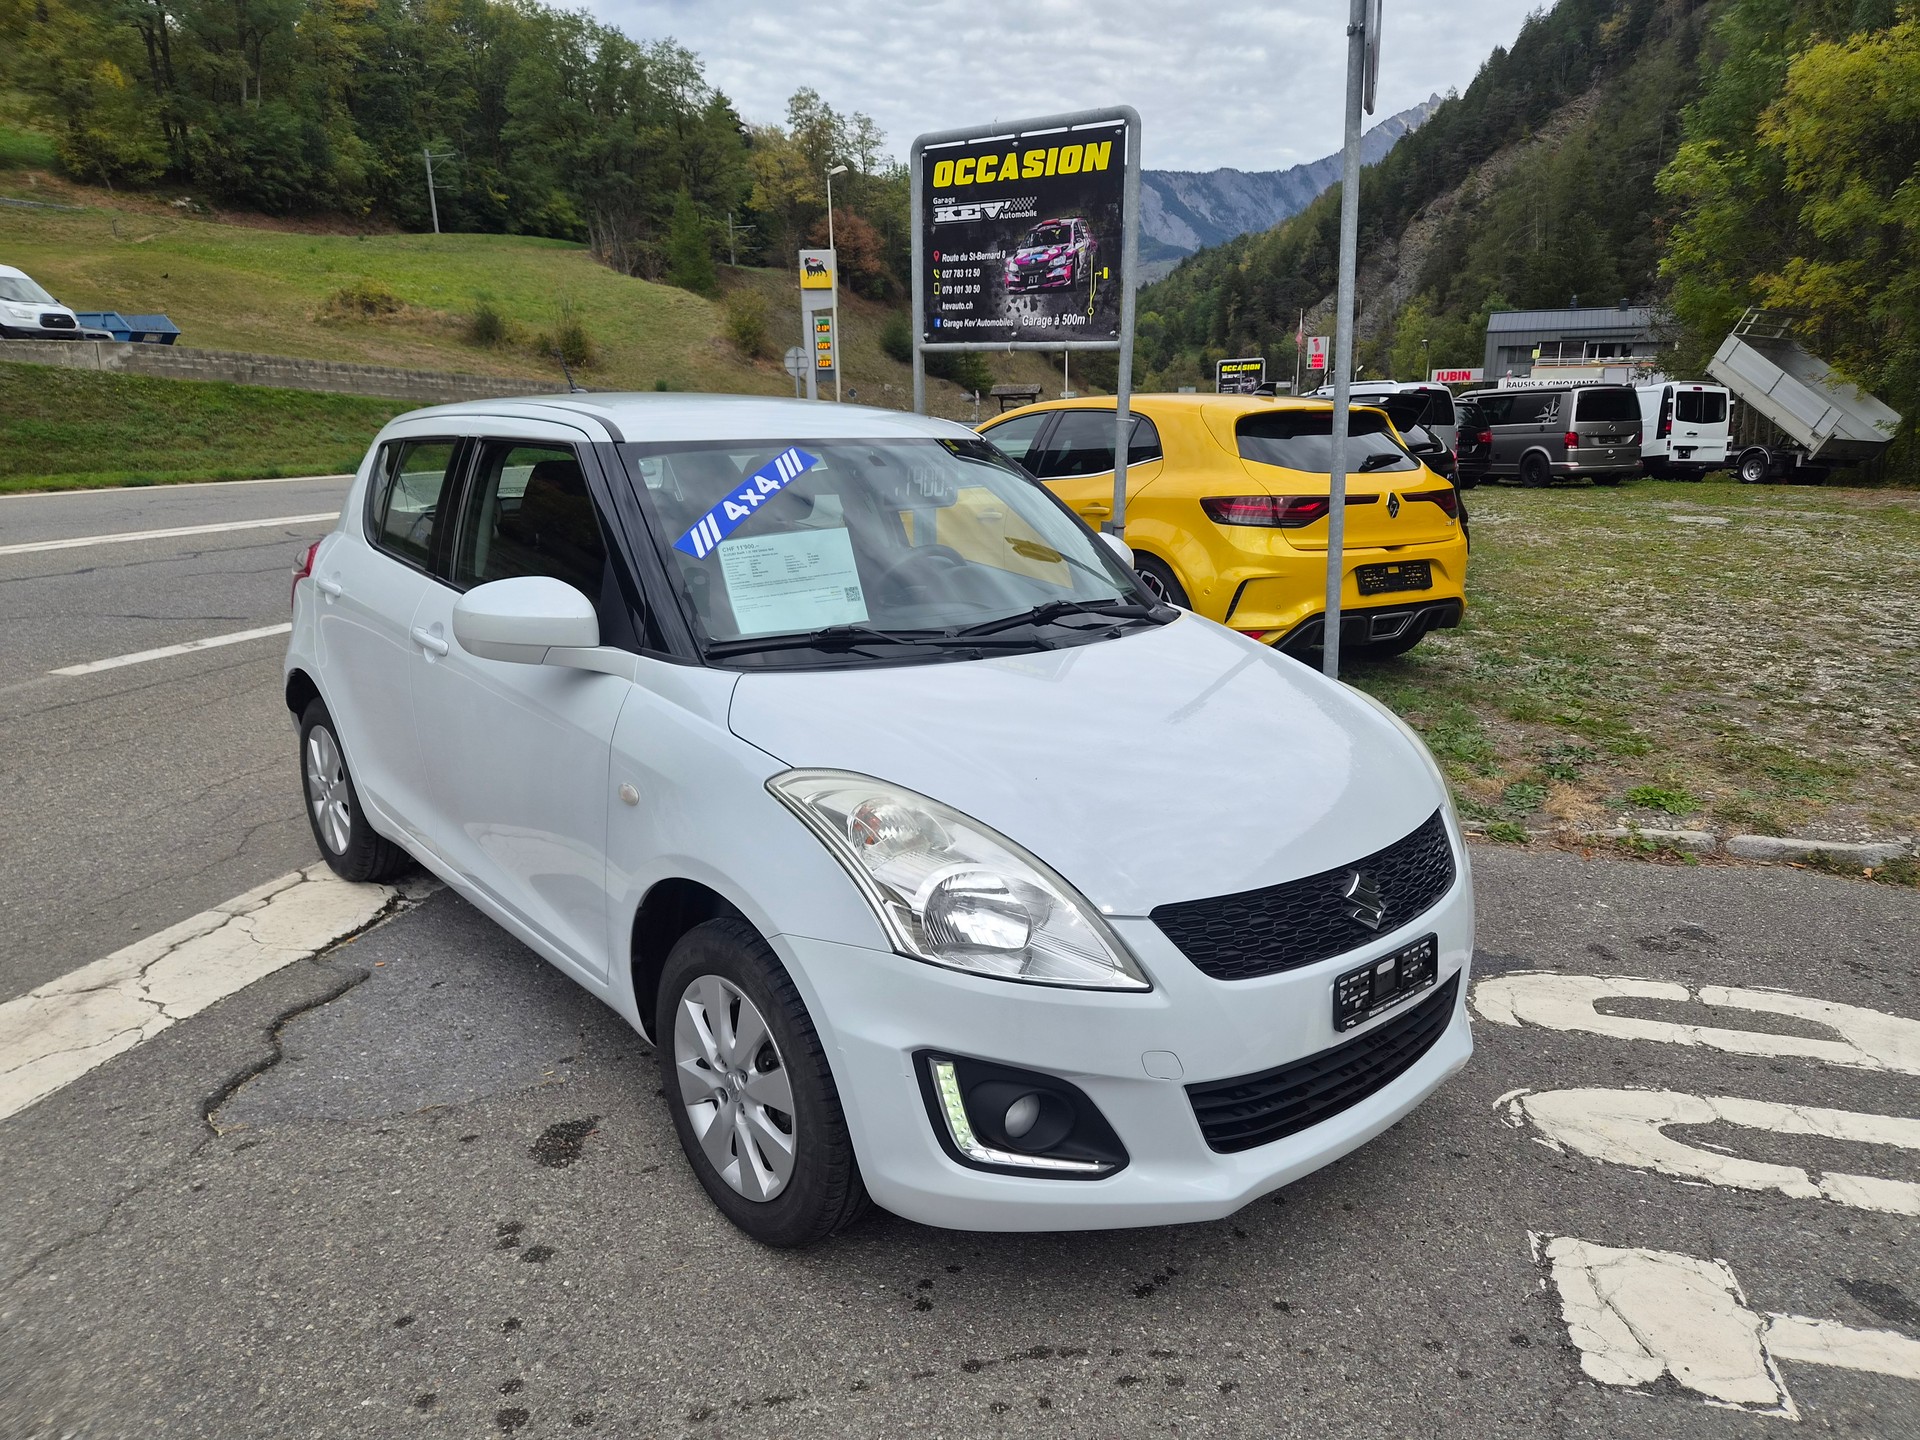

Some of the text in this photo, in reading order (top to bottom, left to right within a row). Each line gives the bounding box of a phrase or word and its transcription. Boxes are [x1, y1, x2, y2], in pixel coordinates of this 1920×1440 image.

[932, 141, 1112, 188] OCCASION
[933, 197, 956, 205] Garage
[942, 254, 959, 263] Route
[960, 252, 968, 262] du
[969, 250, 1001, 261] St-Bernard
[942, 268, 981, 279] 027 783 12 50
[942, 284, 981, 295] 079 101 30 50
[942, 301, 974, 310] kevauto.ch
[942, 319, 963, 329] Garage
[1022, 313, 1086, 329] Garage à 500m
[1221, 363, 1261, 372] OCCASION
[1436, 371, 1471, 382] JUBIN
[1506, 381, 1536, 389] RAUSIS
[722, 474, 781, 521] 4x4
[722, 545, 734, 553] CHF
